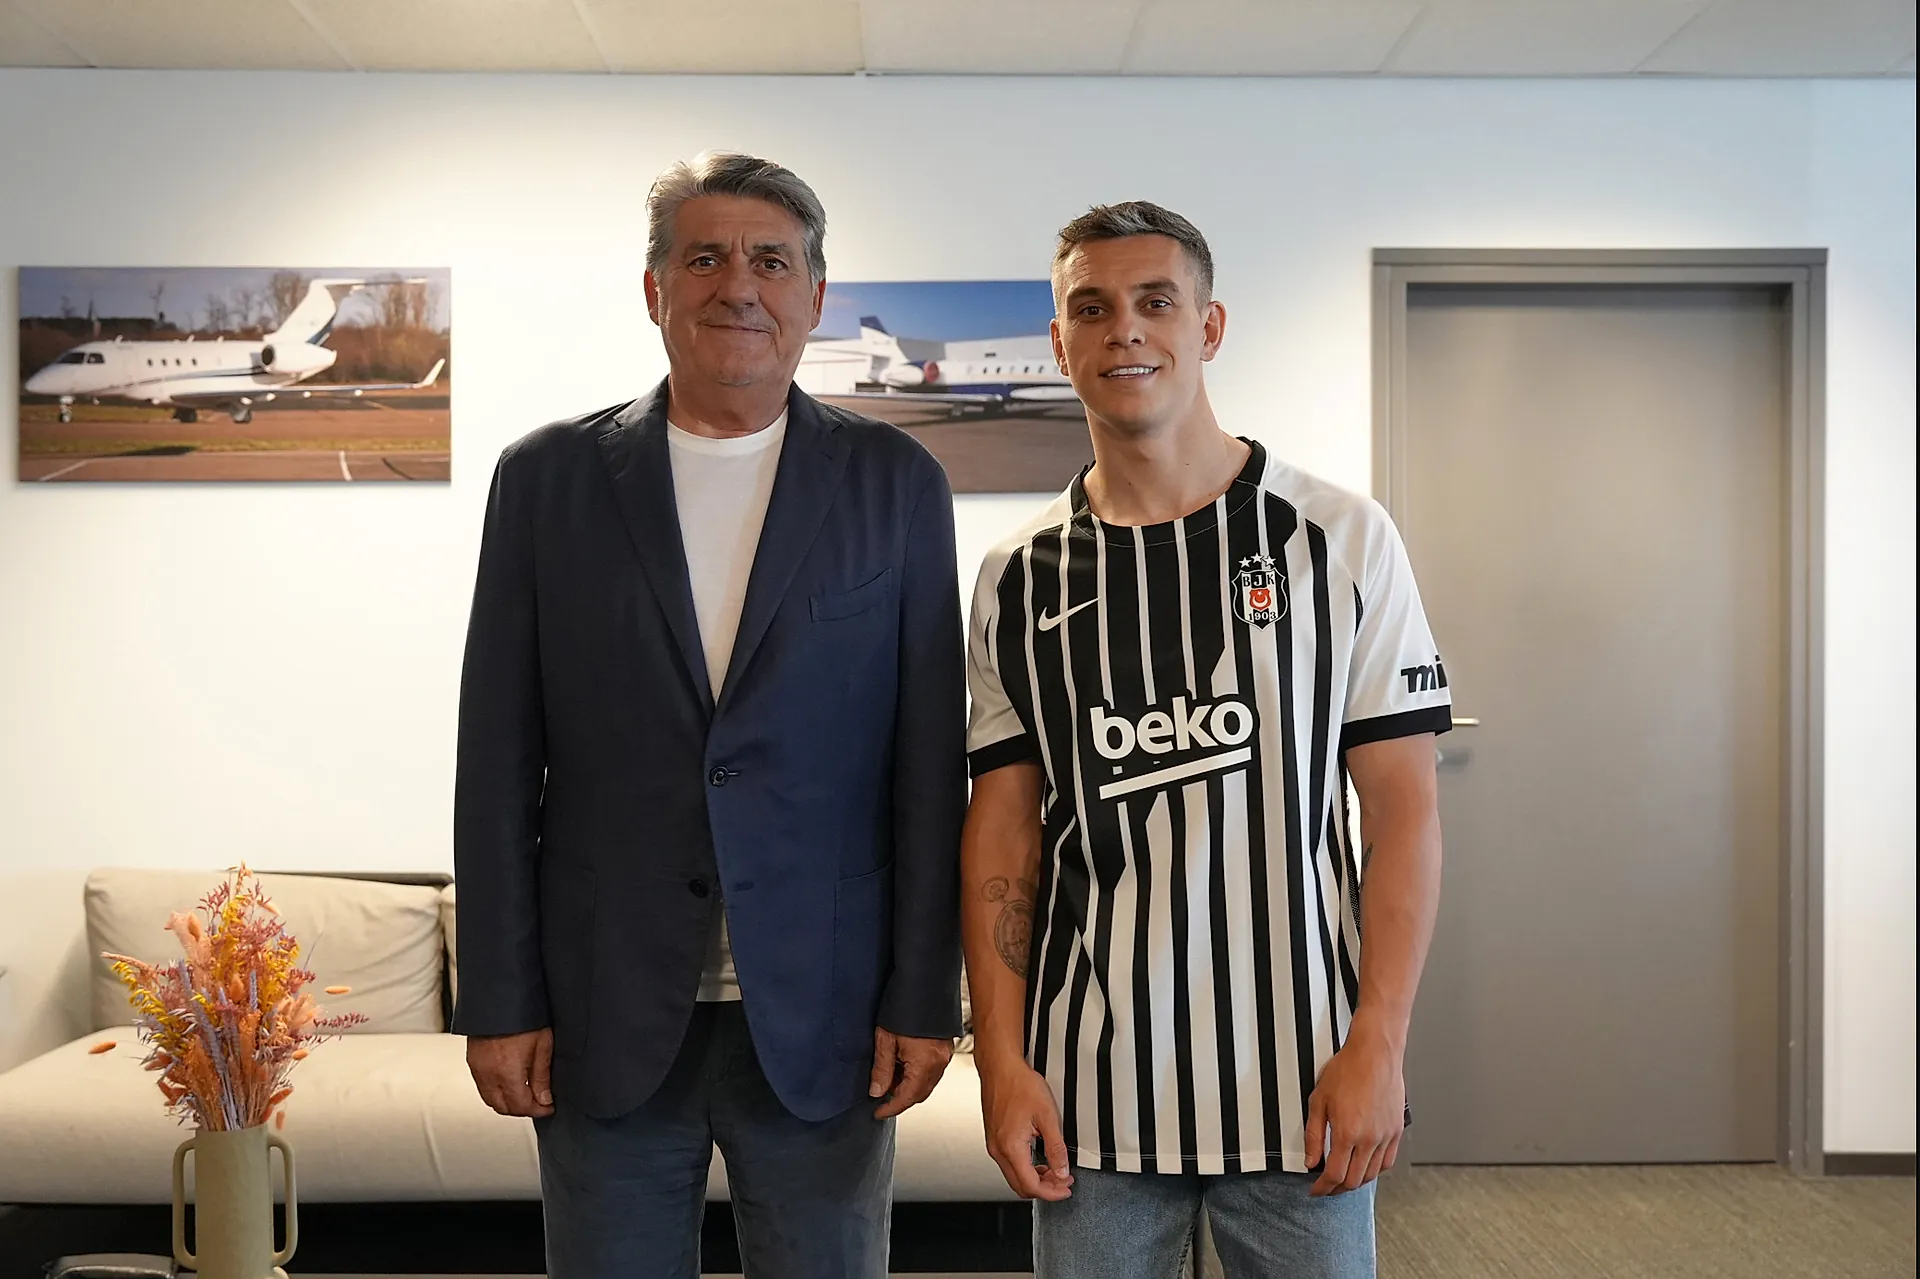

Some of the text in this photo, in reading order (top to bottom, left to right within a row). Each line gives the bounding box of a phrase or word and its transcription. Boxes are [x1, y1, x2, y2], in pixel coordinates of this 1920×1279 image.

[1242, 574, 1275, 587] BJK
[1248, 611, 1276, 621] 1903
[1090, 696, 1253, 760] beko
